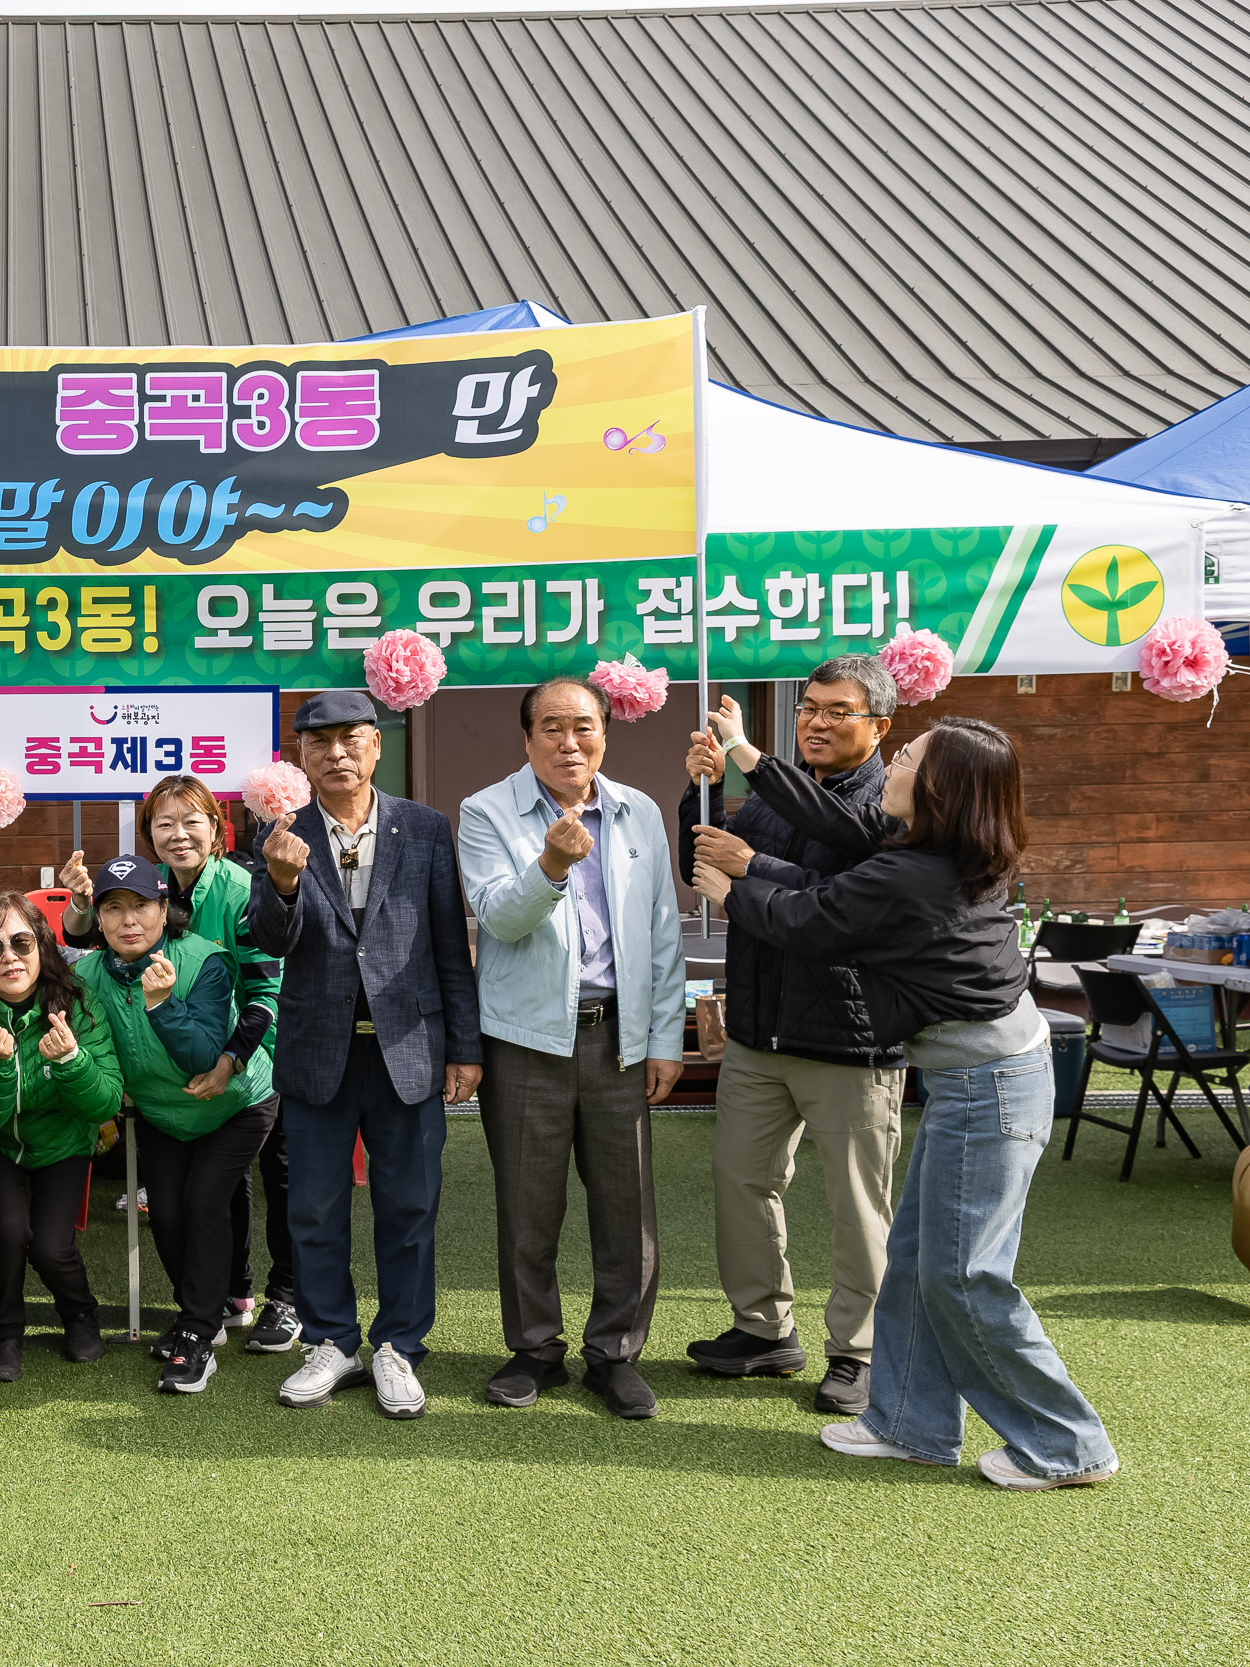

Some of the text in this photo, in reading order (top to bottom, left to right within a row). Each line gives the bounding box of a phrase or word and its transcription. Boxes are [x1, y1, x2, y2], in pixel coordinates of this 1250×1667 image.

[55, 369, 380, 455] 중곡3동
[452, 365, 541, 445] 만
[194, 581, 382, 651] 오늘은
[415, 578, 605, 647] 우리가
[636, 571, 910, 643] 접수한다!
[121, 711, 160, 726] 행복광진
[24, 736, 228, 775] 중곡제3동
